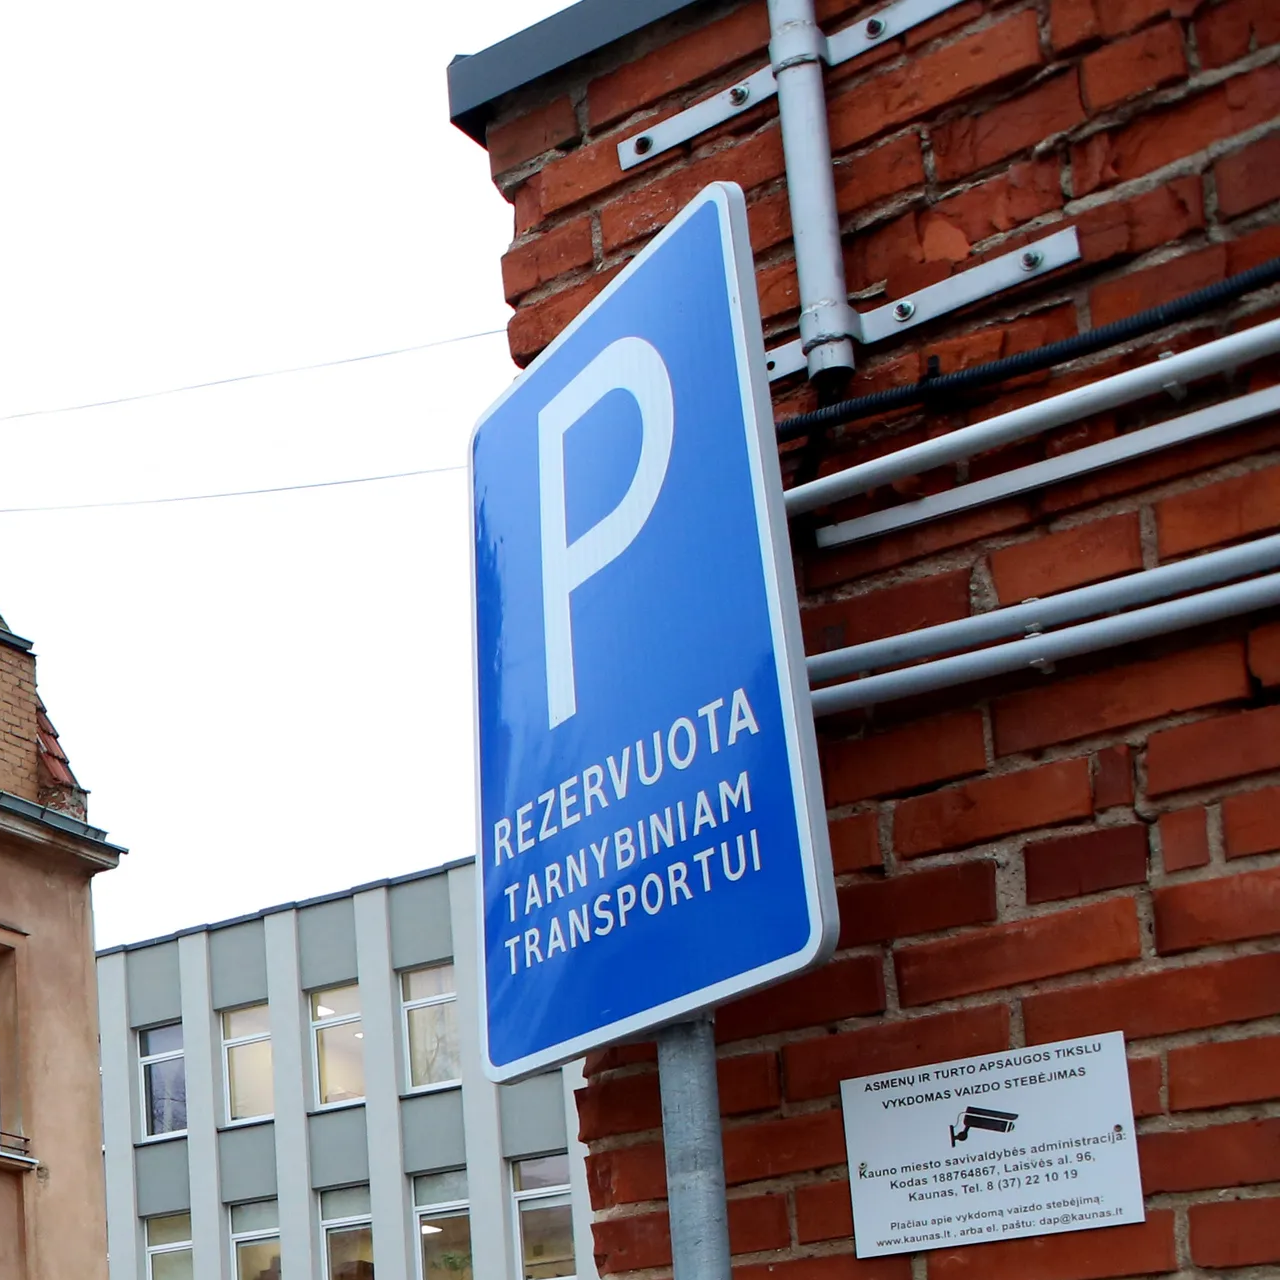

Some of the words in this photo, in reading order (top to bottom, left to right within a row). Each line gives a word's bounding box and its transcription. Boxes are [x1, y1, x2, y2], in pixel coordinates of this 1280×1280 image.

[538, 336, 674, 730] P
[494, 688, 760, 867] REZERVUOTA
[504, 771, 752, 923] TARNYBINIAM
[505, 830, 762, 975] TRANSPORTUI
[864, 1075, 914, 1092] ASMENŲ
[919, 1073, 931, 1083] IR
[934, 1065, 976, 1080] TURTO
[979, 1051, 1051, 1072] APSAUGOS
[1054, 1042, 1102, 1059] TIKSLU
[882, 1089, 951, 1109] VYKDOMAS
[954, 1081, 1000, 1097] VAIZDO
[1004, 1066, 1086, 1089] STEBĖJIMAS
[859, 1168, 898, 1180] Kauno
[900, 1160, 942, 1174] miesto
[944, 1147, 1026, 1167] savivaldybės
[1030, 1131, 1127, 1154] administracija:
[890, 1178, 928, 1190] Kodas
[932, 1165, 1000, 1183] 188764867,
[1004, 1159, 1053, 1173] Laisvės
[1057, 1154, 1072, 1165] al.
[1076, 1151, 1096, 1163] 96,
[908, 1188, 958, 1202] Kaunas,
[961, 1183, 983, 1194] Tel.
[986, 1181, 994, 1191] 8
[997, 1177, 1021, 1192] (37)
[1025, 1174, 1040, 1186] 22
[1044, 1171, 1059, 1183] 10
[1063, 1169, 1078, 1180] 19
[876, 1230, 951, 1247] www.kaunas.lt
[959, 1225, 983, 1237] arba
[986, 1224, 999, 1233] el.
[1001, 1219, 1036, 1233] paštu:
[1039, 1207, 1124, 1226] dap@kaunas.lt
[890, 1219, 928, 1231] Plačiau
[930, 1215, 953, 1226] apie
[956, 1209, 1004, 1223] vykdomą
[1007, 1203, 1043, 1215] vaizdo
[1046, 1195, 1104, 1209] stebėjimą:
